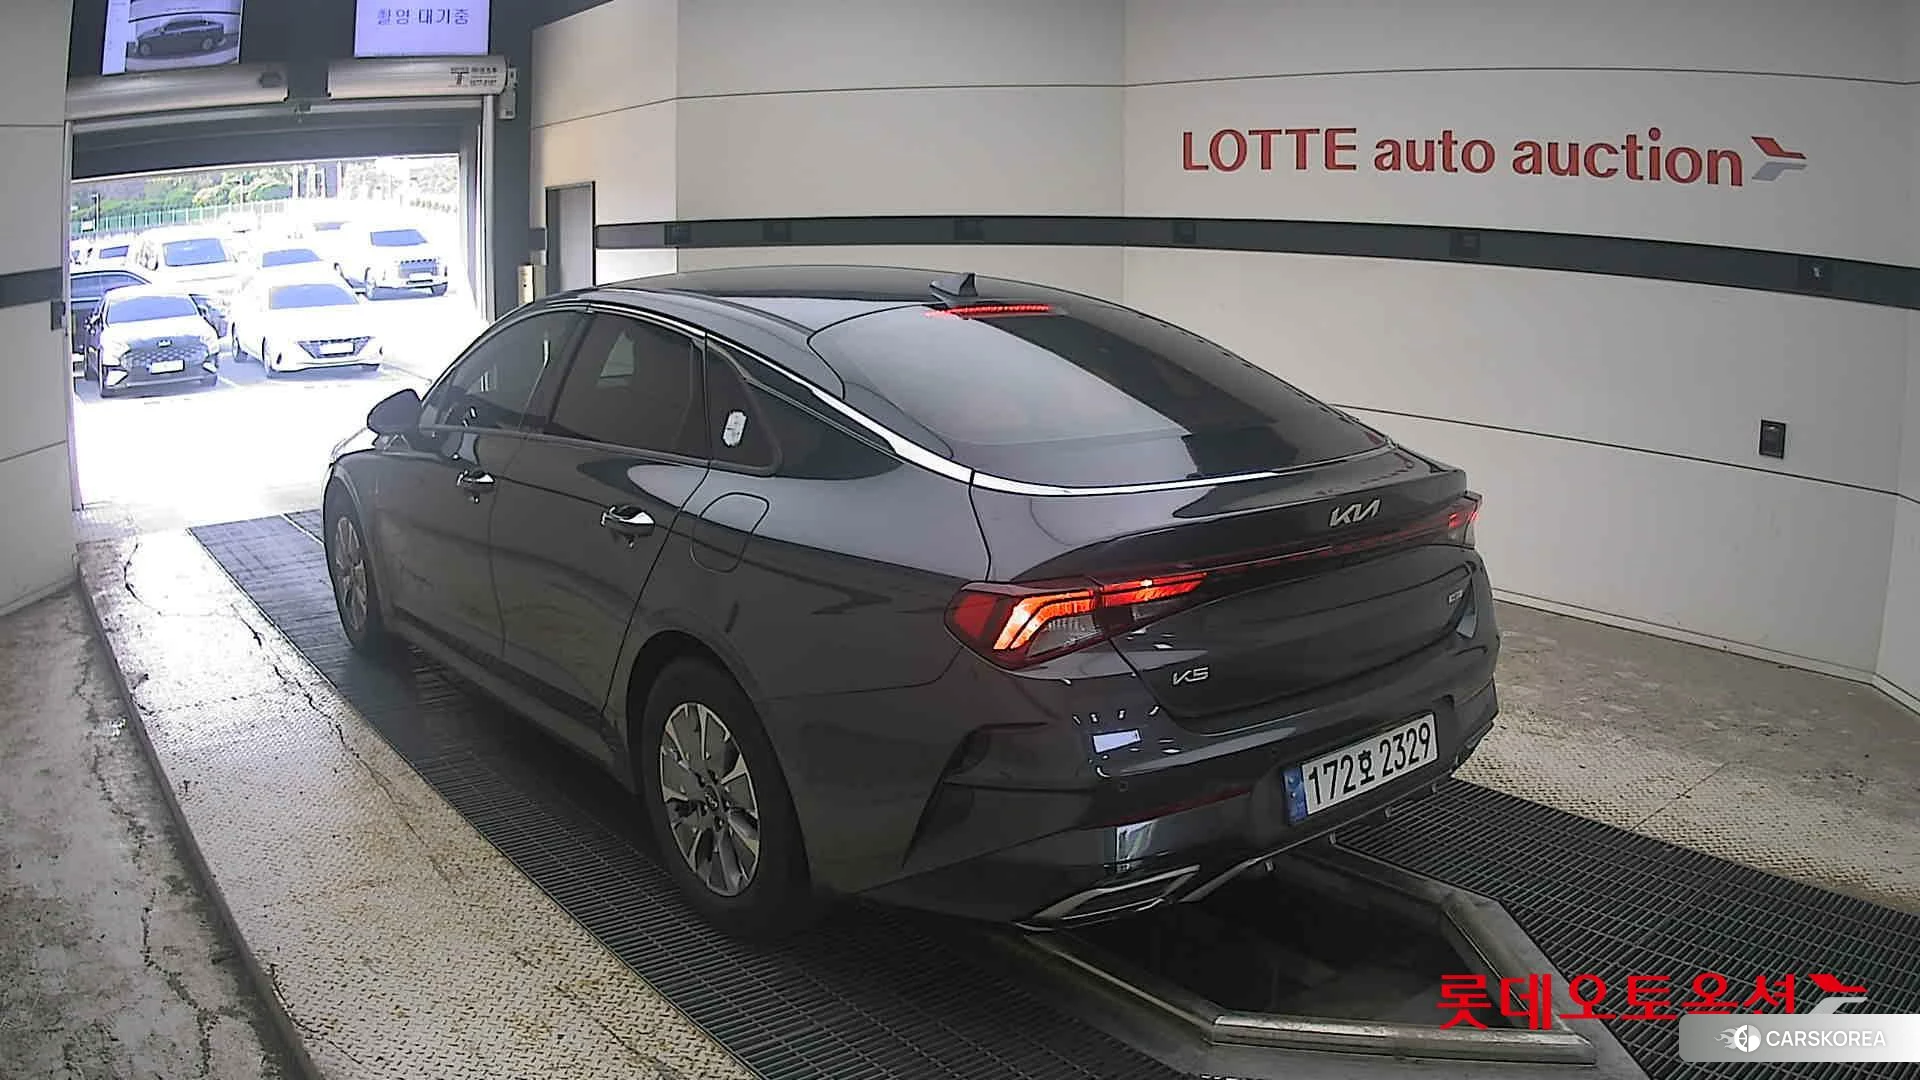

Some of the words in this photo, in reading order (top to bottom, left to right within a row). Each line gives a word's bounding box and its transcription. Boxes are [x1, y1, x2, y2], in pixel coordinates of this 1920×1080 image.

[418, 8, 469, 25] 대기중
[1182, 128, 1357, 171] LOTTE
[1374, 131, 1495, 173] auto
[1512, 127, 1742, 186] auction
[1328, 498, 1381, 528] KIA
[1171, 666, 1210, 687] K5
[1308, 750, 1375, 805] 172호
[1379, 722, 1431, 778] 2329
